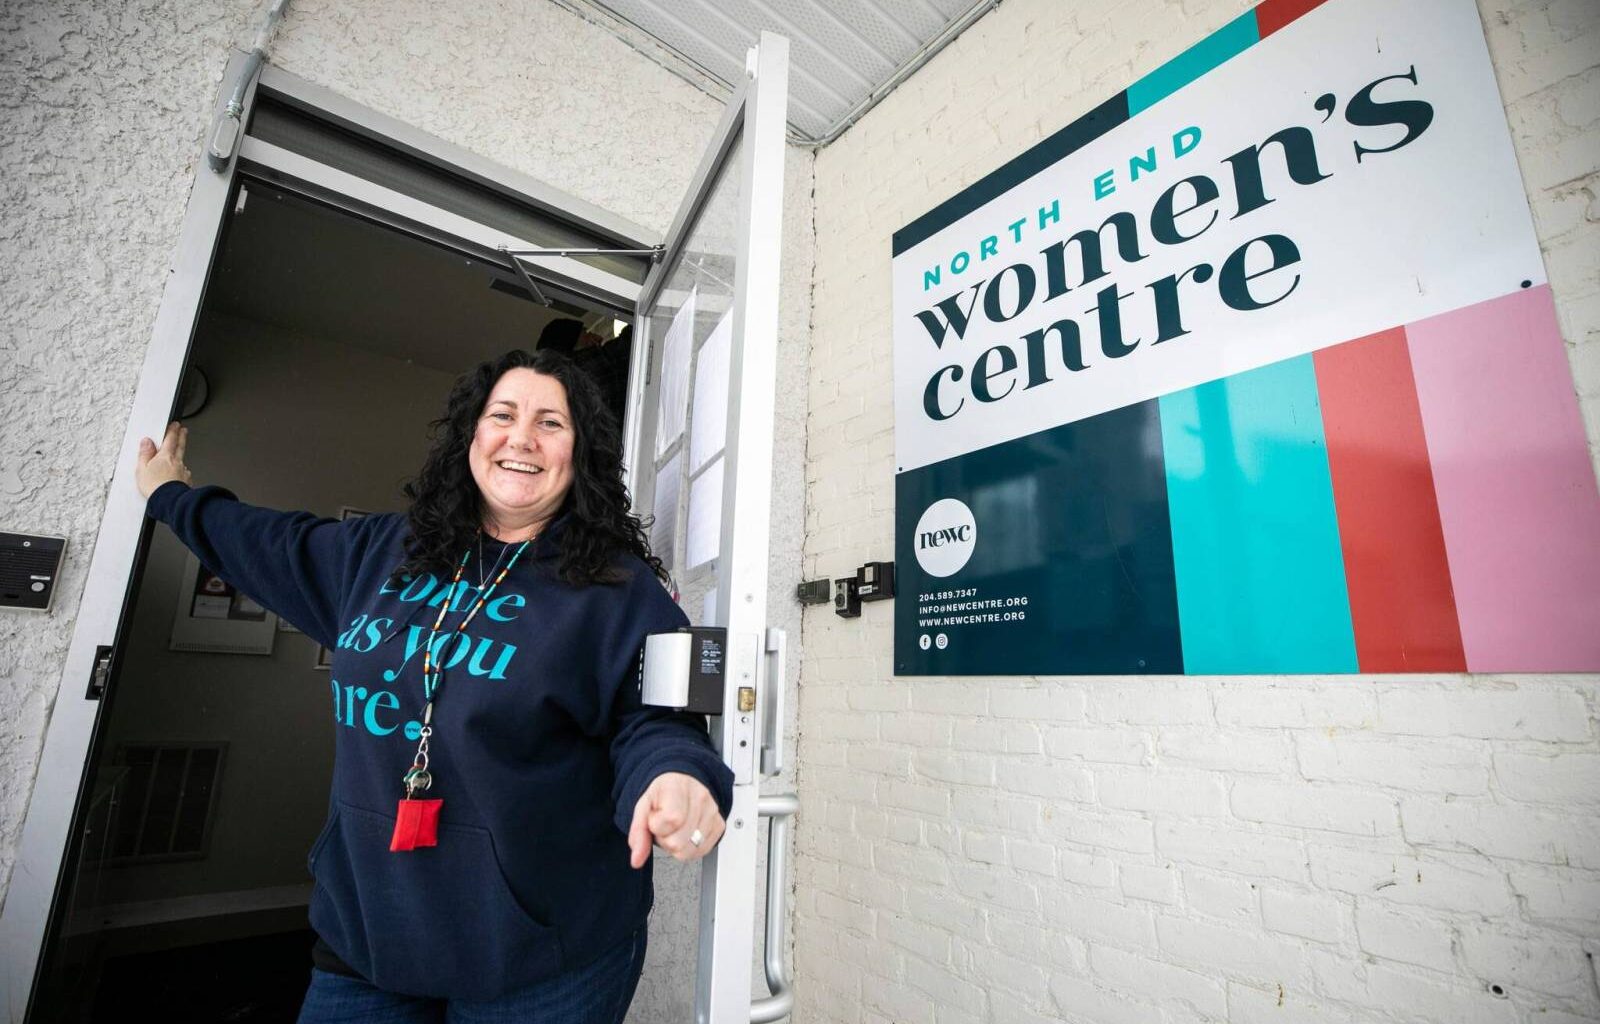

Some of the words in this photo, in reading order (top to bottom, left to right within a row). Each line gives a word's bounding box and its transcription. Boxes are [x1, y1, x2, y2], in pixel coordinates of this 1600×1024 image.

[923, 200, 1060, 292] NORTH
[1093, 126, 1203, 201] END
[922, 234, 1302, 421] centre
[920, 525, 971, 549] newc
[919, 588, 977, 602] 204.589.7347
[919, 597, 1028, 615] INFO@NEWCENTRE.ORG
[919, 611, 1025, 627] WWW.NEWCENTRE.ORG
[337, 614, 394, 653] as
[383, 624, 518, 682] you
